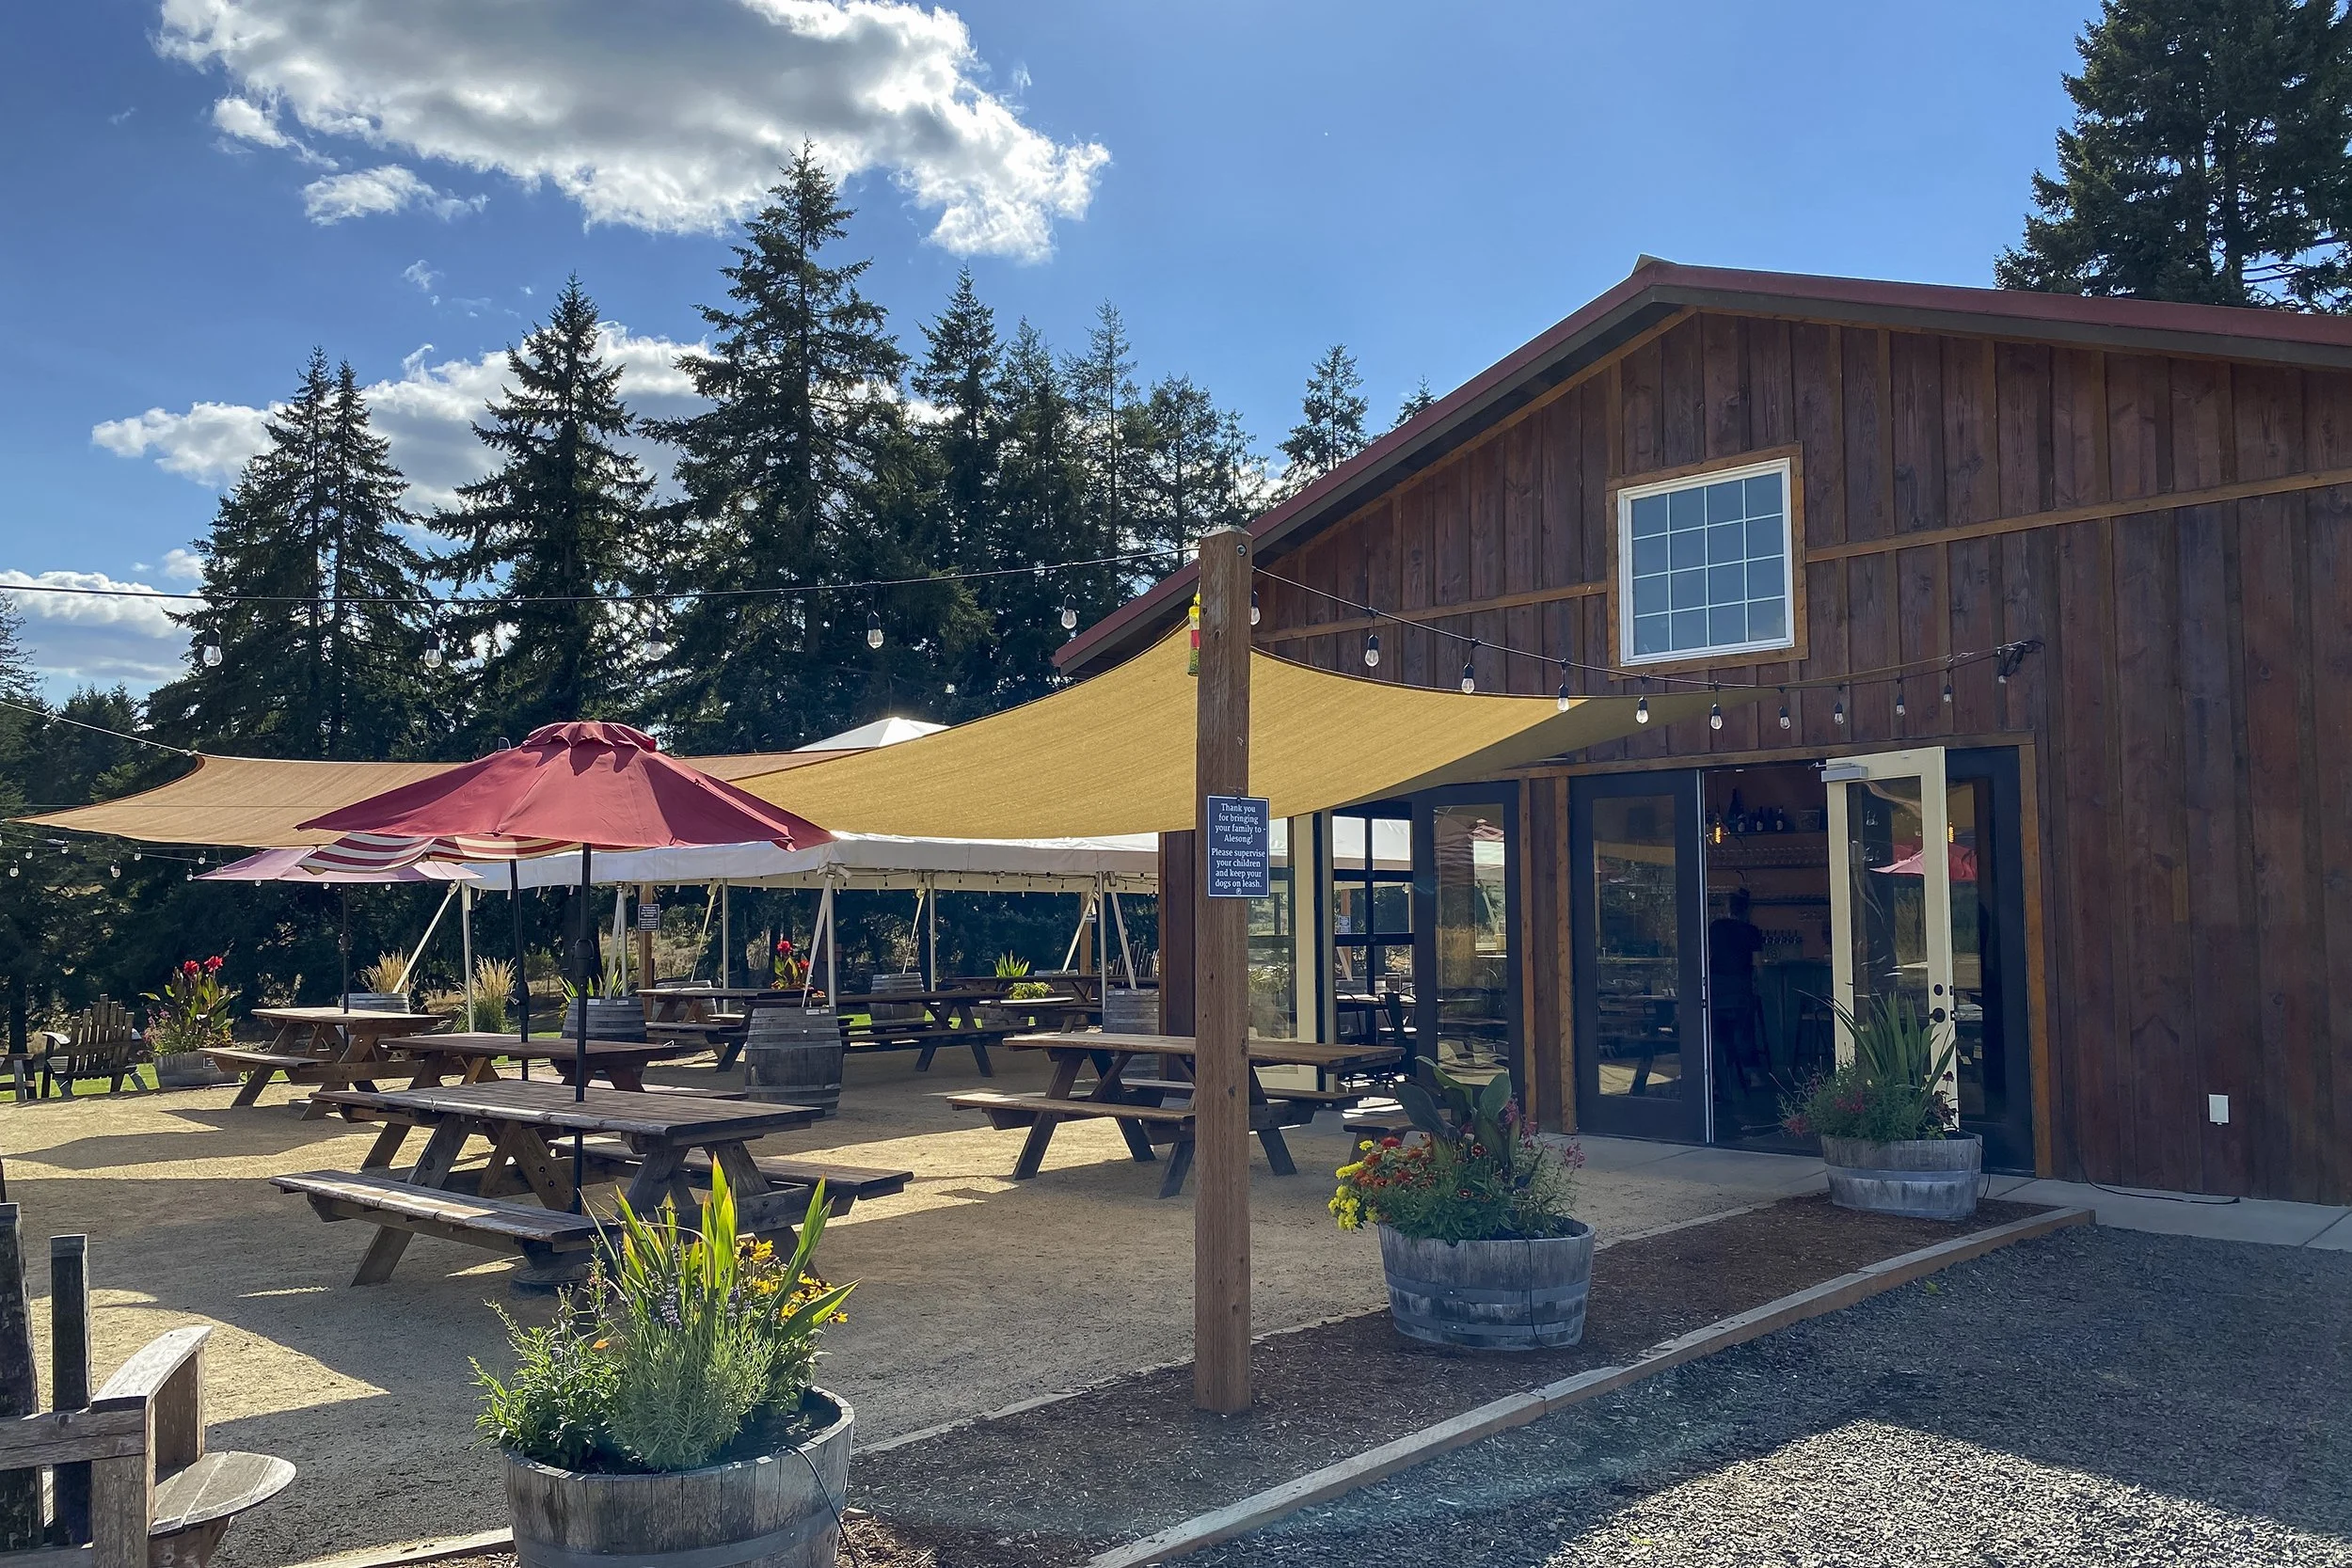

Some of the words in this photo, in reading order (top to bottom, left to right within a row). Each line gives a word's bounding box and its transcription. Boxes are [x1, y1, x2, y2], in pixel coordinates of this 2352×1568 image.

[1221, 803, 1242, 812] Thank
[1231, 815, 1258, 824] bringing
[1216, 825, 1230, 833] your
[1232, 824, 1253, 834] family
[1224, 834, 1253, 845] Alesong!
[1234, 848, 1265, 858] supervise
[1216, 860, 1232, 868] your
[1231, 869, 1246, 879] keep
[1247, 871, 1262, 879] your
[1216, 879, 1231, 889] dogs
[1243, 879, 1262, 888] leash.
